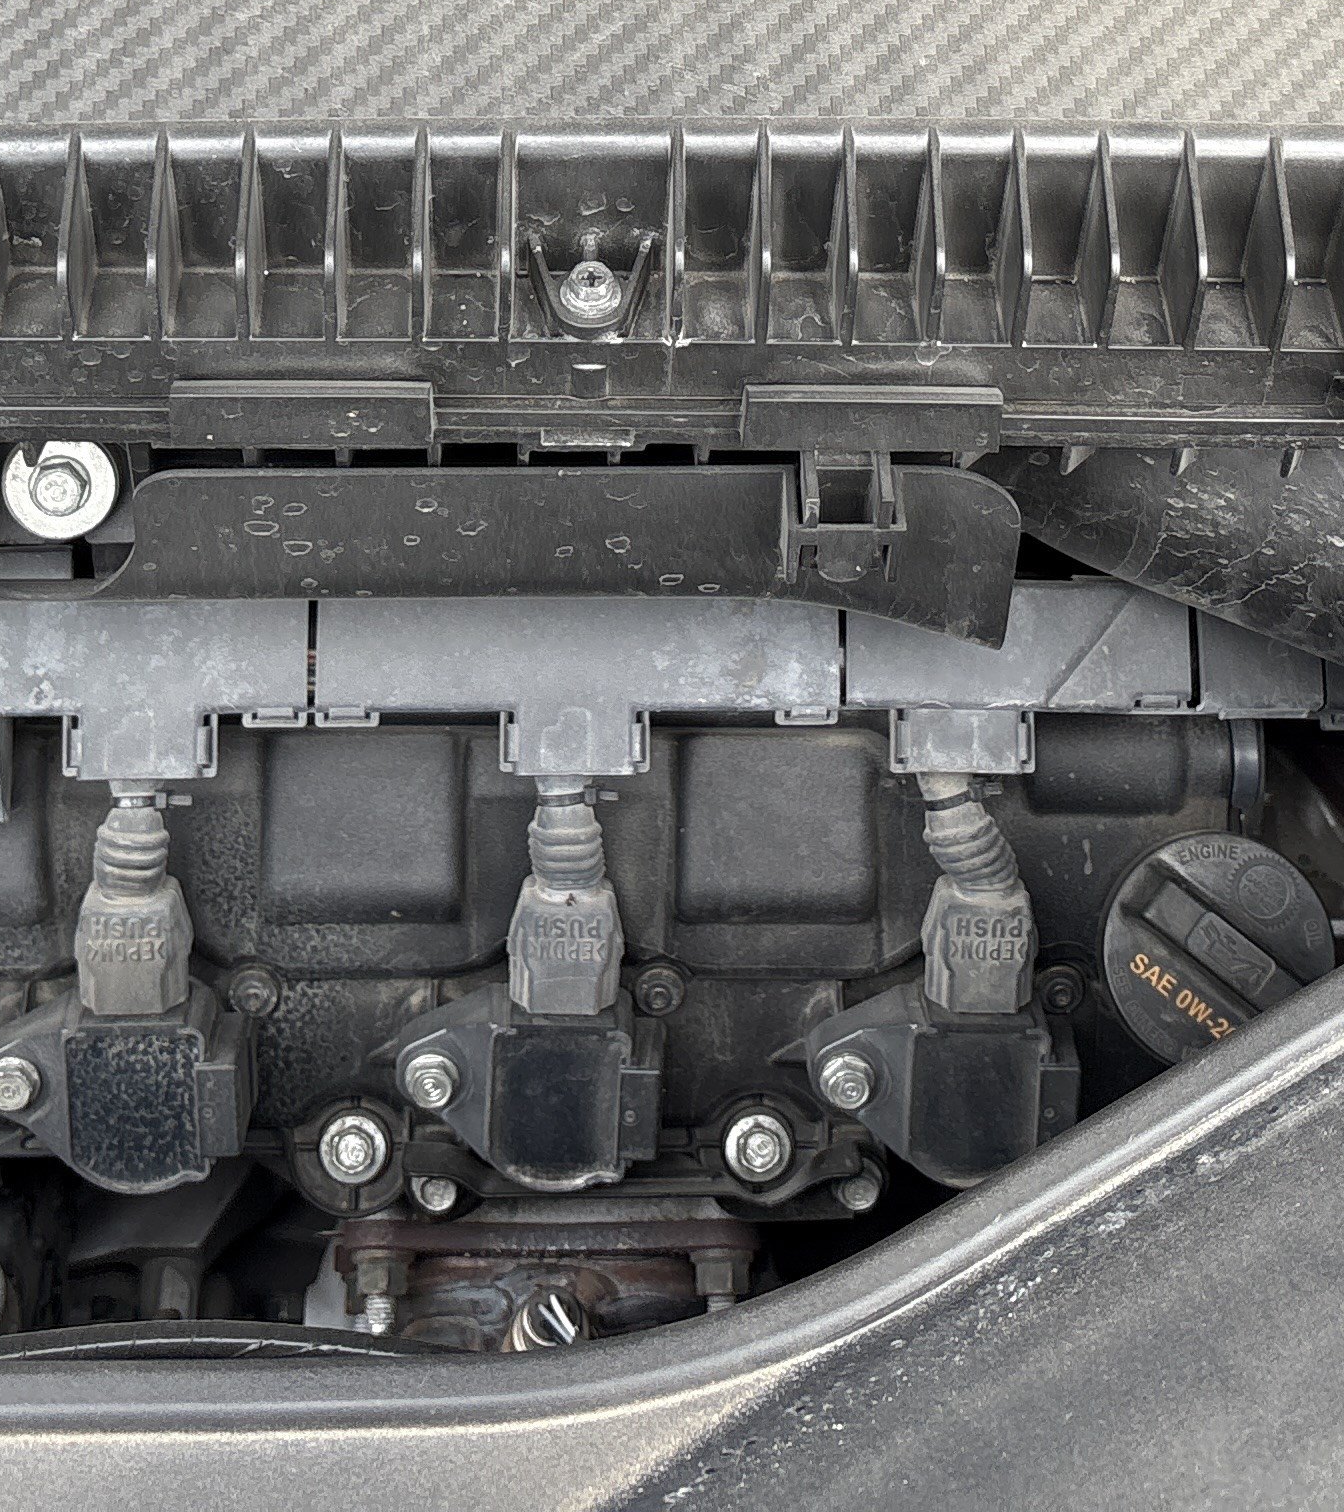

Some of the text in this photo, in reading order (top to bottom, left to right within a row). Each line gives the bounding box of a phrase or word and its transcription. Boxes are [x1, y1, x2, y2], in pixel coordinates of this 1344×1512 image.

[1175, 842, 1242, 866] ENGINE
[90, 917, 162, 939] PUSH
[534, 917, 602, 939] PUSH
[955, 917, 1023, 939] PUSH
[1129, 953, 1178, 998] SAE
